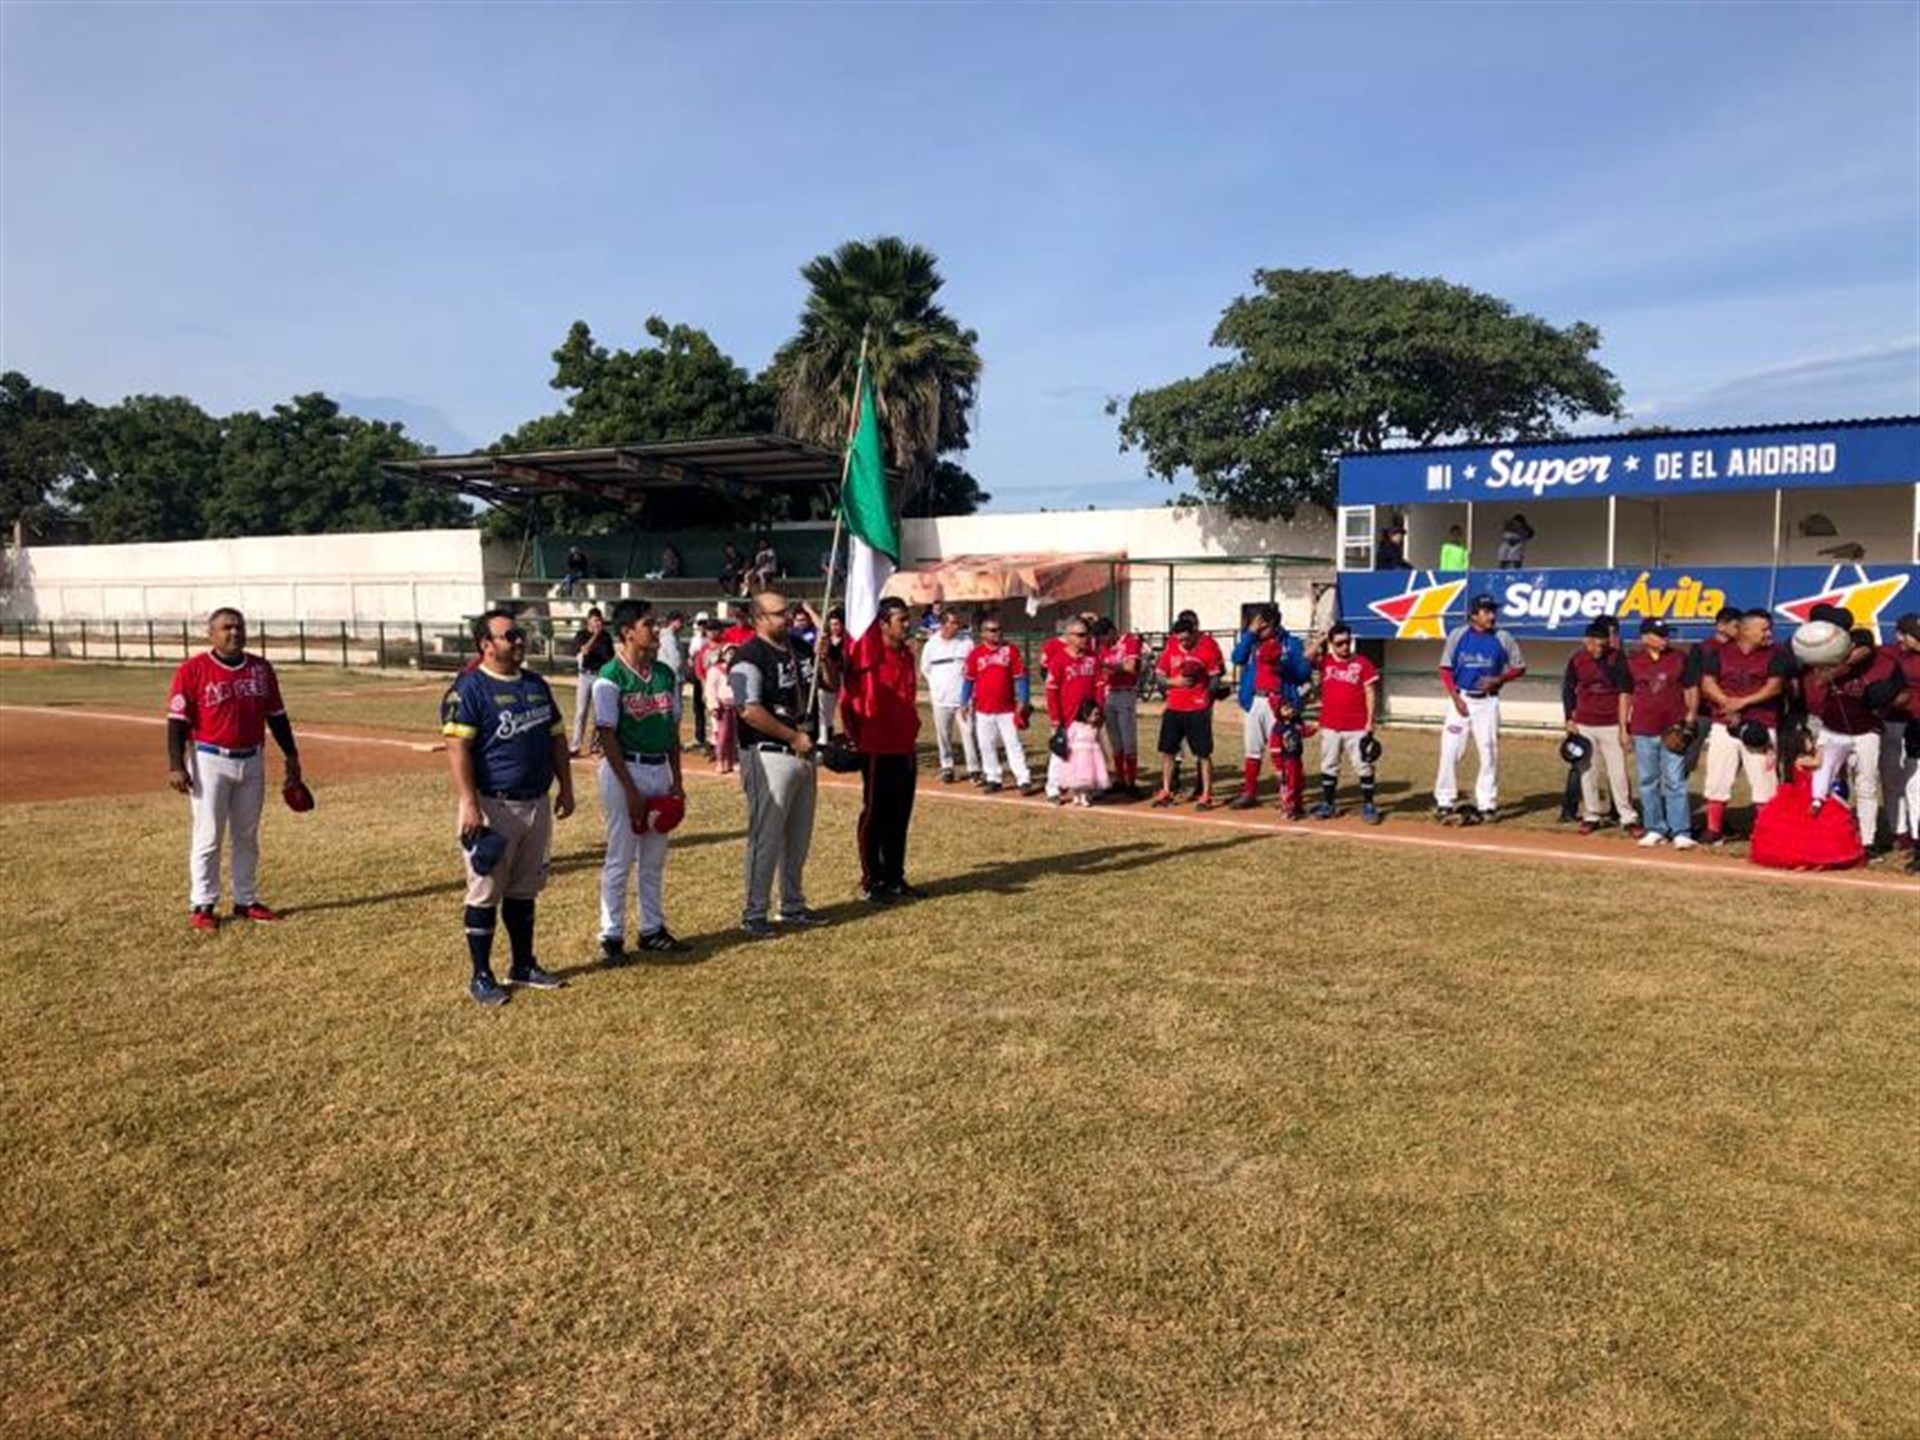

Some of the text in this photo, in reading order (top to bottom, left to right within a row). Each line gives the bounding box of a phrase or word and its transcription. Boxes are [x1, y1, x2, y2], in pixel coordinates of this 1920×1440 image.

[1427, 442, 1837, 496] MI Super DE EL AHORRO
[1502, 571, 1725, 629] SuperÁvila
